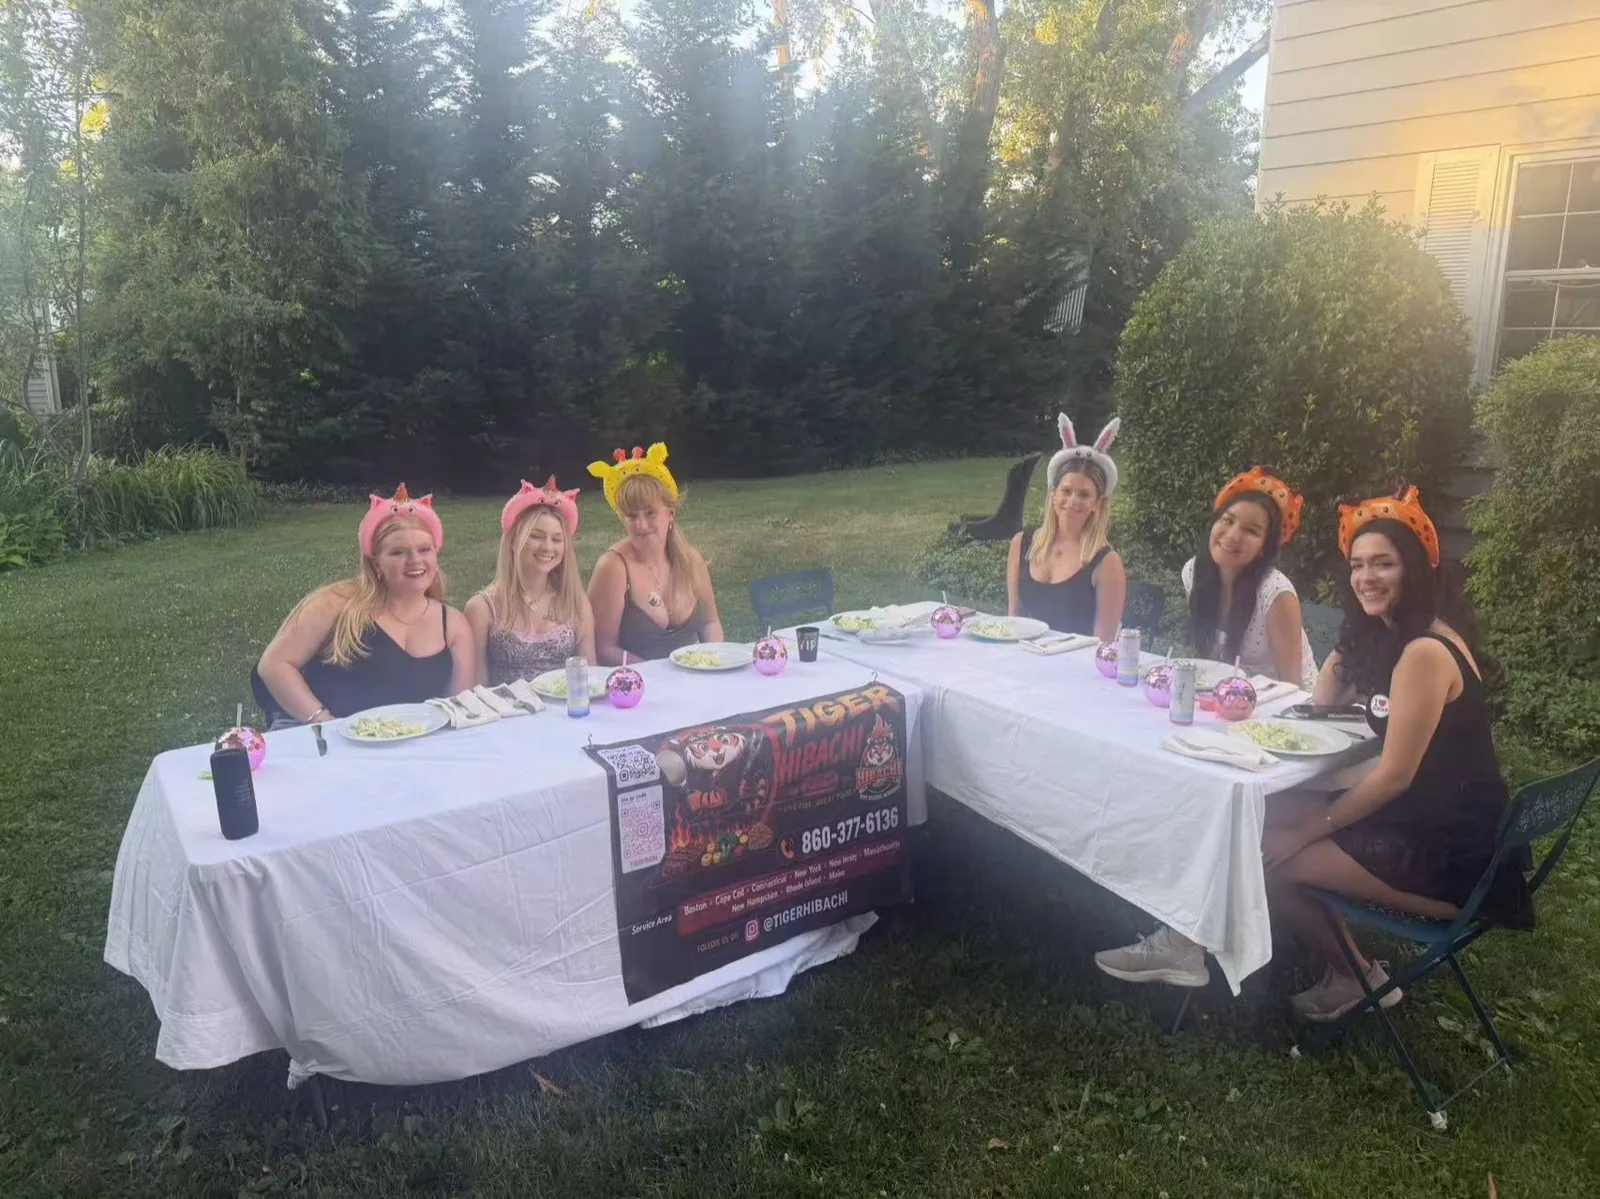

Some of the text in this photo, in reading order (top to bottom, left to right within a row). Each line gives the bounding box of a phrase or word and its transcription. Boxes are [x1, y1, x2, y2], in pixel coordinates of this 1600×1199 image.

[800, 640, 817, 651] VIP
[761, 685, 898, 748] TIGER
[778, 724, 865, 790] HIBACHI
[856, 757, 903, 790] HIBACHI
[802, 806, 899, 853] 860-377-6136
[684, 840, 901, 915] Boston Cape Cod Connecticut New York New Jersey Massachusetts
[731, 869, 846, 913] New Hampshire Rhode Island Maine
[632, 914, 672, 935] Service Area
[763, 889, 848, 932] @TIGERHIBACHI
[697, 935, 720, 953] FOLLOW
